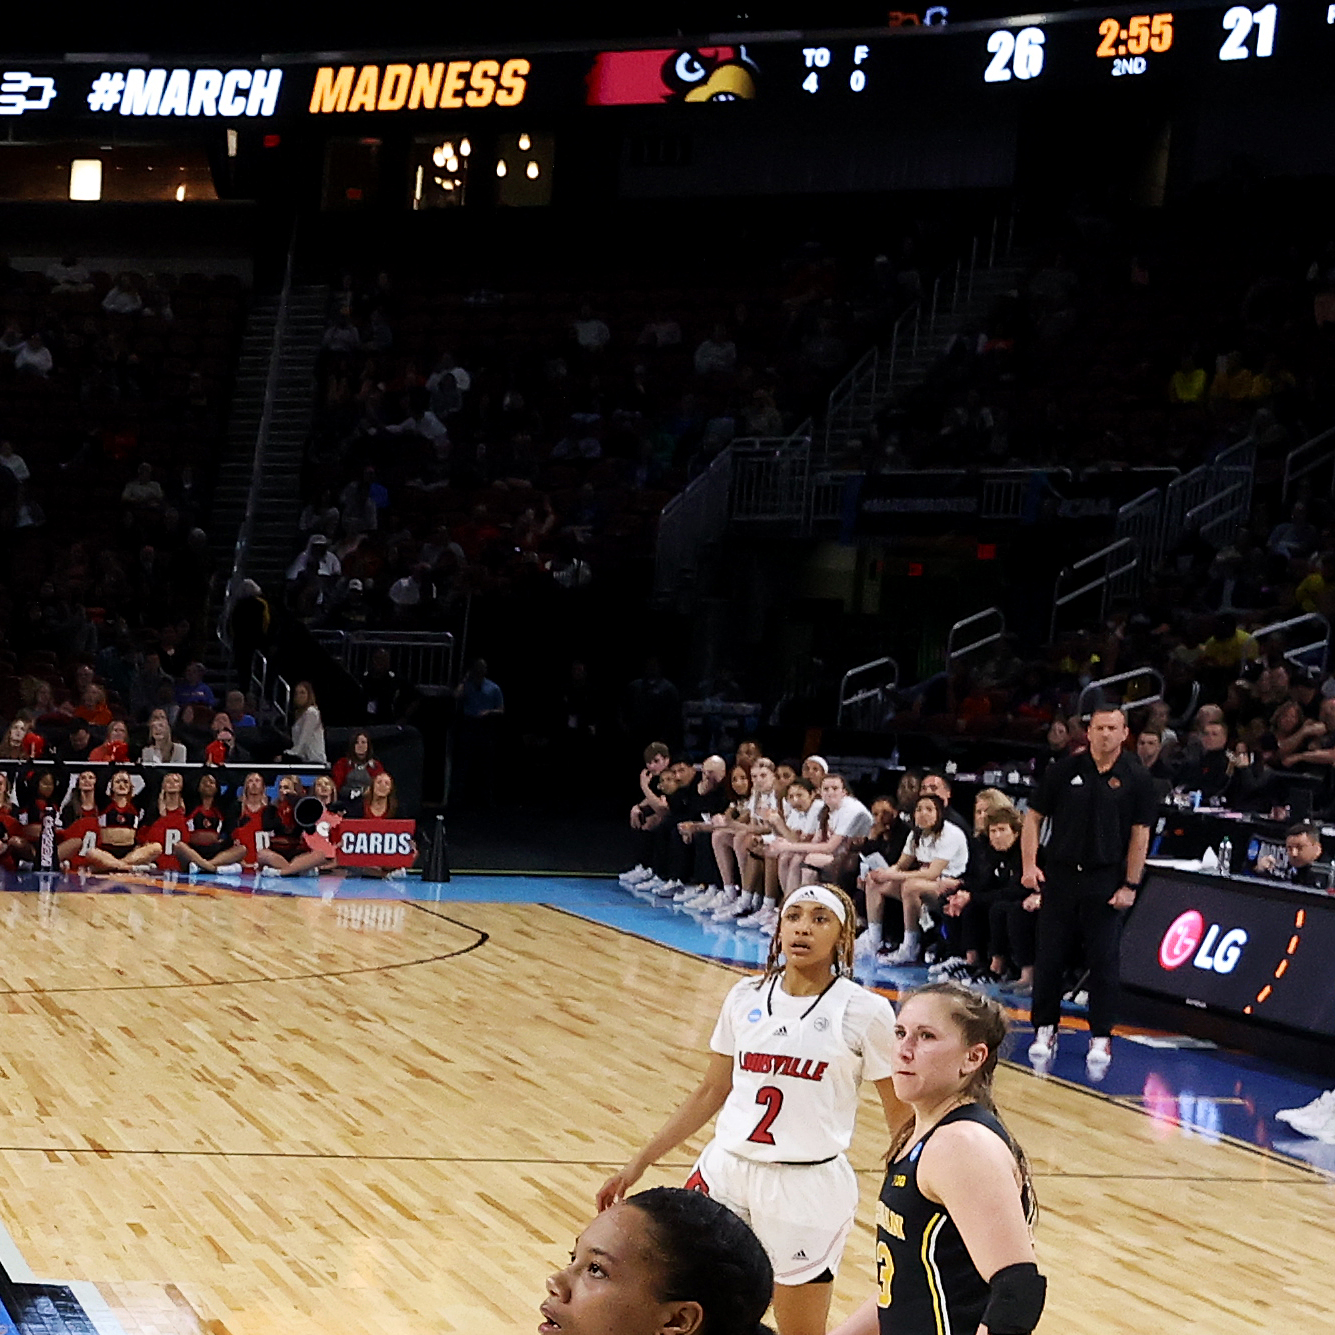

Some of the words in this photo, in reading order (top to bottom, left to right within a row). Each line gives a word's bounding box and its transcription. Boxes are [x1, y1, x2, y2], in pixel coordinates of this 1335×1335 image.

[984, 27, 1046, 83] 26
[1096, 13, 1174, 58] 2:55
[1219, 3, 1278, 61] 21
[803, 47, 830, 67] TO
[853, 45, 869, 65] F
[1112, 57, 1147, 76] 2ND
[87, 68, 283, 118] #MARCH
[308, 58, 531, 116] MADNESS
[802, 72, 819, 93] 4
[849, 70, 866, 92] 0
[341, 832, 411, 855] CARDS
[1193, 924, 1248, 974] LG
[739, 1050, 830, 1082] LOUISVILLE
[747, 1086, 785, 1146] 2
